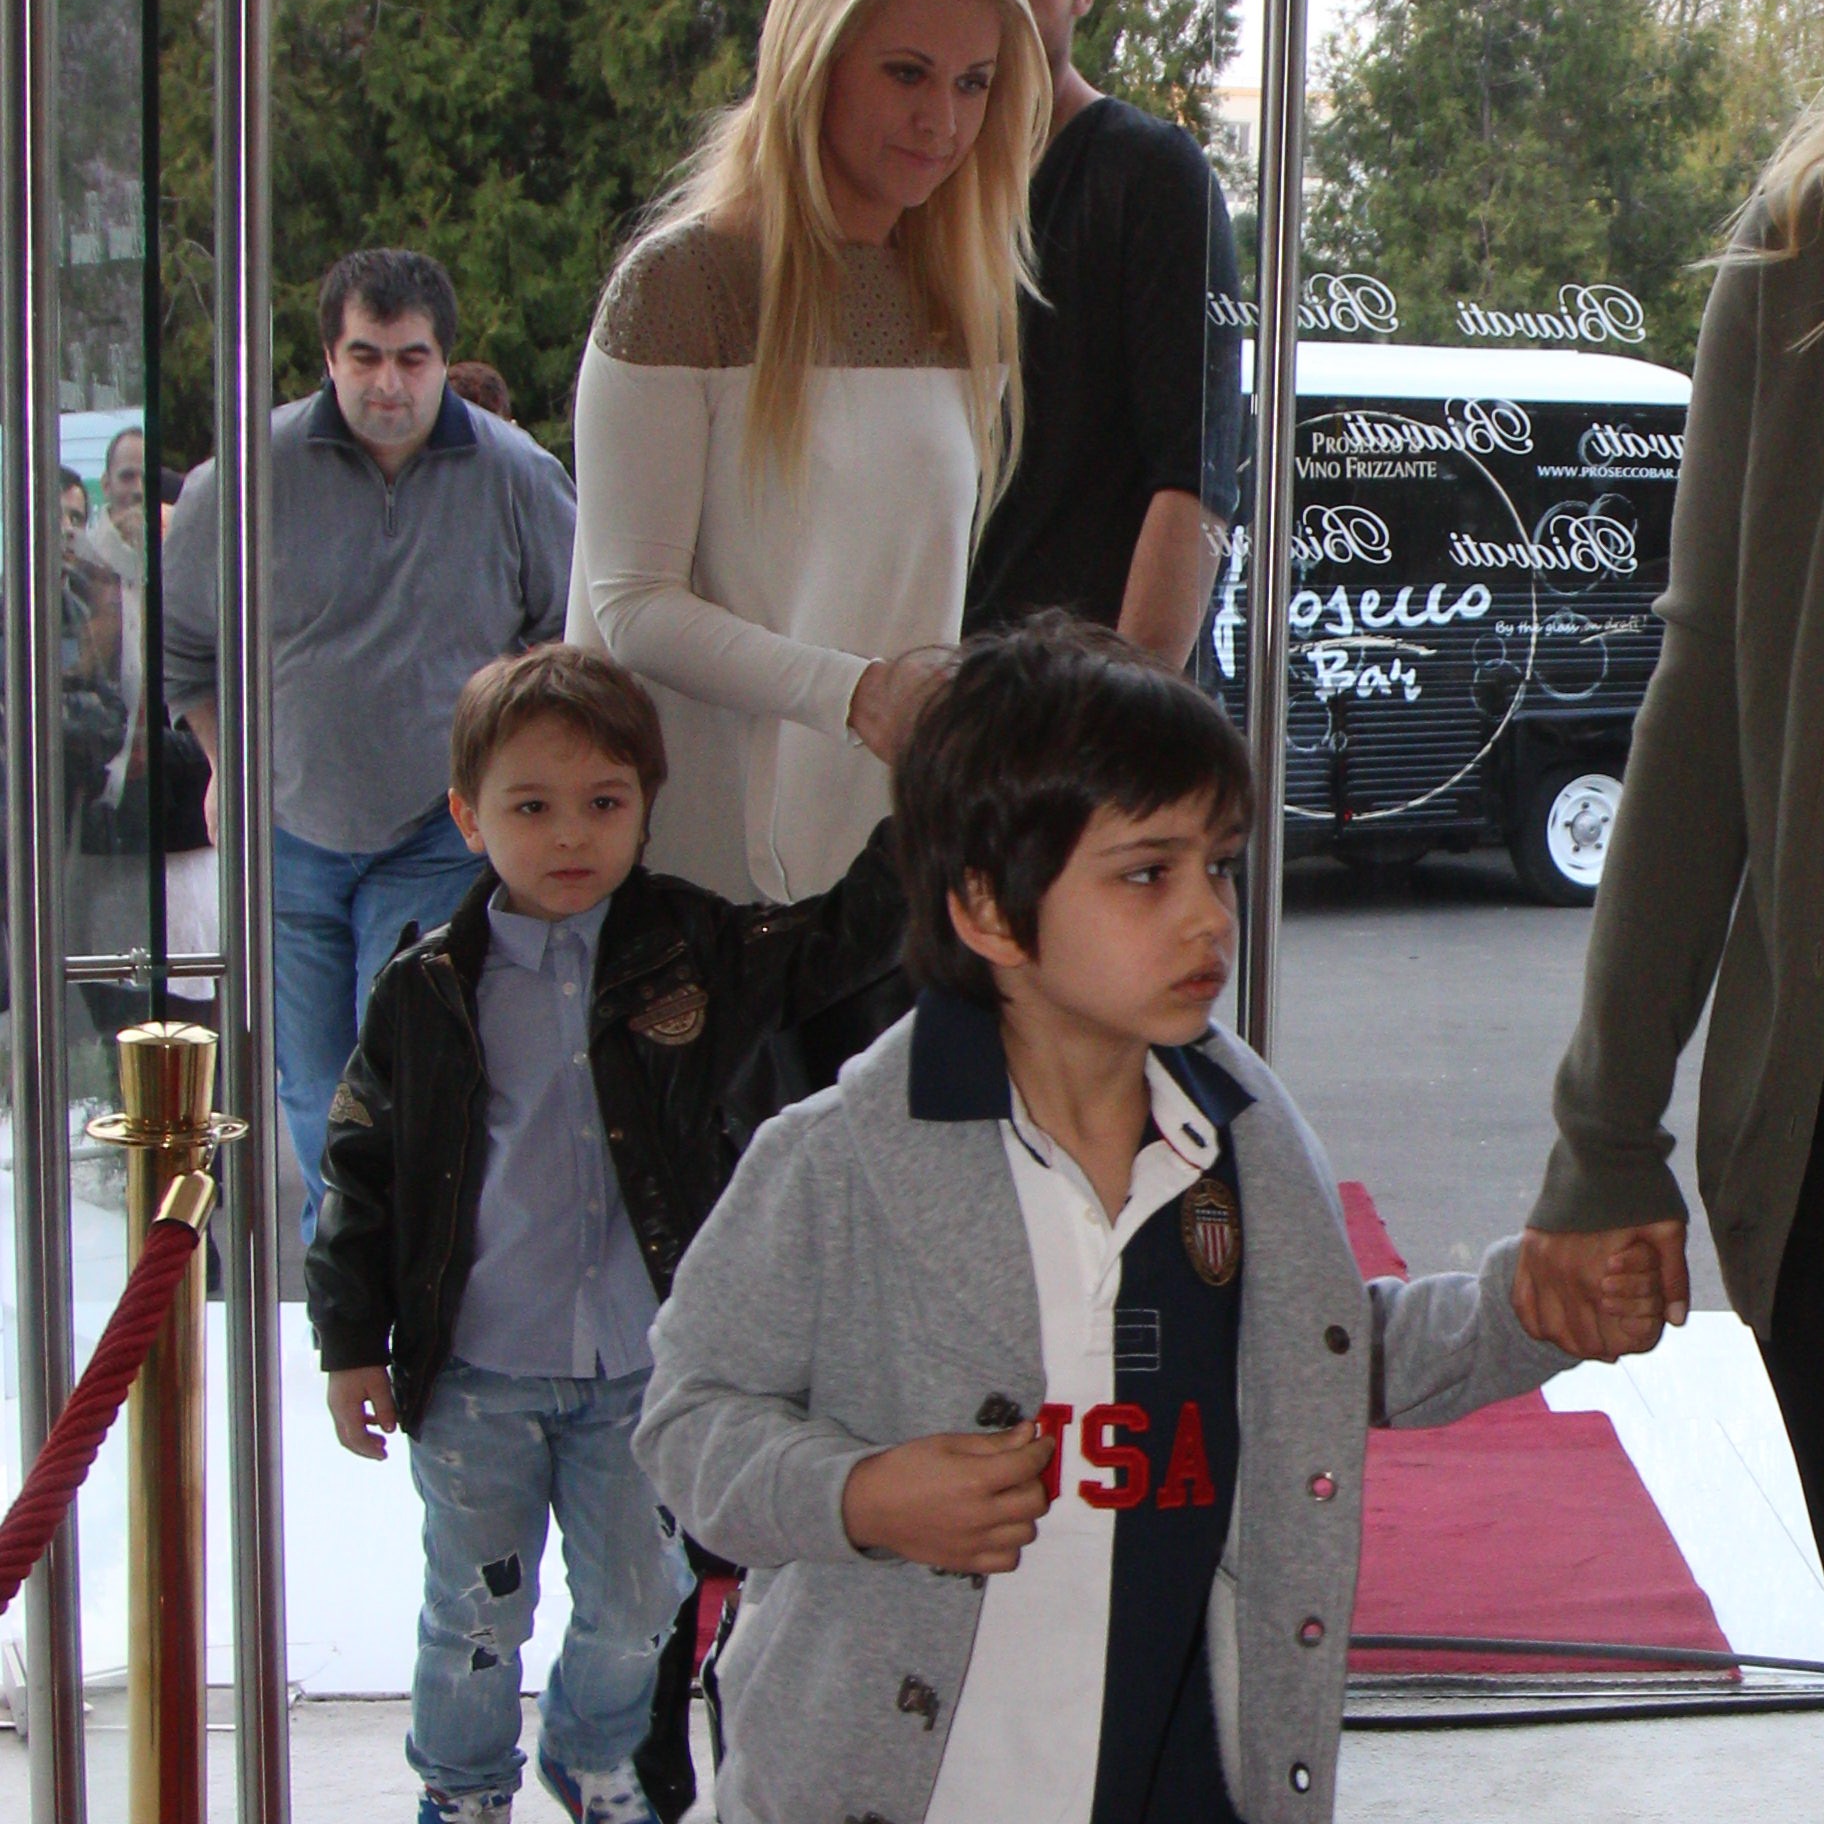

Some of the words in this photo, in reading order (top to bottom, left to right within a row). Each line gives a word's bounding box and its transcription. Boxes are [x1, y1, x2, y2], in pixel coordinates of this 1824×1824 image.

[1295, 457, 1341, 479] VINO
[1346, 457, 1437, 479] FRIZZANTE
[1495, 620, 1514, 636] By
[1307, 643, 1422, 701] Bar
